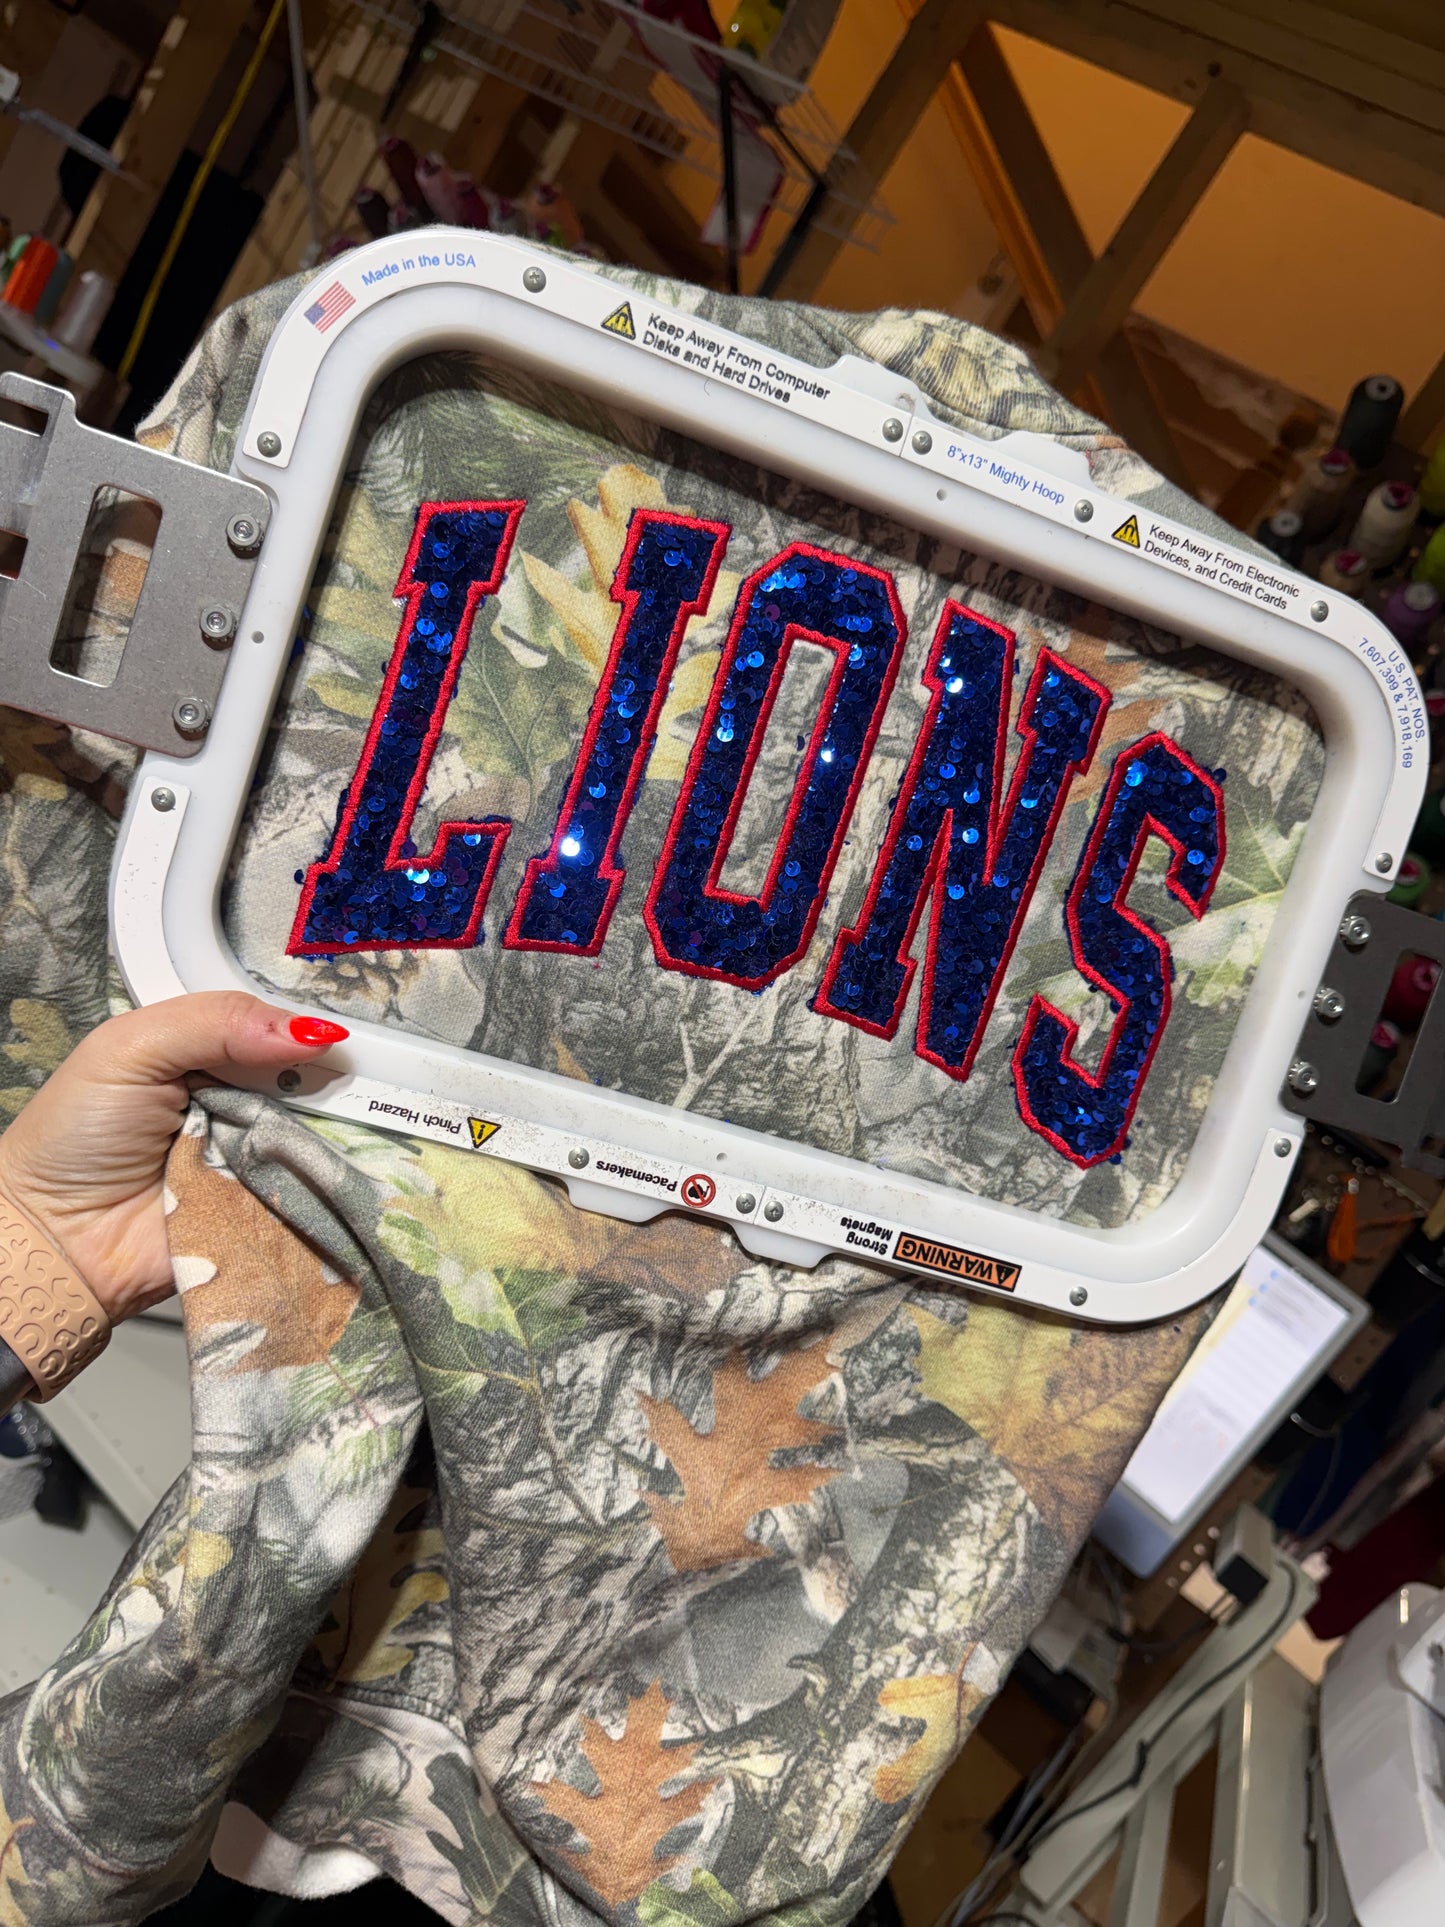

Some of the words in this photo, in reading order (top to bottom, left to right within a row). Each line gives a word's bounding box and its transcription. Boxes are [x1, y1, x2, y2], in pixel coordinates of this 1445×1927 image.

[361, 264, 400, 286] Made
[401, 258, 415, 271] in
[418, 254, 440, 267] the
[444, 253, 477, 268] USA
[642, 330, 680, 357] Disks
[683, 349, 711, 370] and
[712, 360, 746, 385] Hard
[748, 374, 791, 404] Drives
[647, 312, 685, 340] Keep
[685, 330, 725, 357] Away
[726, 346, 762, 372] From
[765, 362, 831, 401] Computer
[989, 462, 1031, 491] Mighty
[1032, 480, 1065, 505] Hoop
[1144, 540, 1191, 572] Devices,
[1194, 563, 1218, 581] and
[1219, 572, 1252, 596] Credit
[1254, 587, 1288, 611] Cards
[1149, 524, 1180, 547] Keep
[1180, 538, 1213, 562] Away
[1214, 552, 1244, 575] From
[1245, 566, 1300, 598] Electronic
[1358, 637, 1400, 691] 7,607,399
[1388, 650, 1406, 678] U.S.
[1402, 677, 1419, 706] PAT.
[1412, 707, 1425, 743] NOS.
[1393, 693, 1404, 703] &
[1397, 704, 1413, 769] 7,918,169
[285, 499, 1227, 1168] LIONS
[368, 1100, 420, 1124] Hazard
[422, 1113, 462, 1135] Pinch
[595, 1160, 678, 1192] Pacemakers
[840, 1216, 893, 1242] Magnets
[845, 1231, 888, 1255] Strong
[901, 1238, 993, 1280] WARNING
